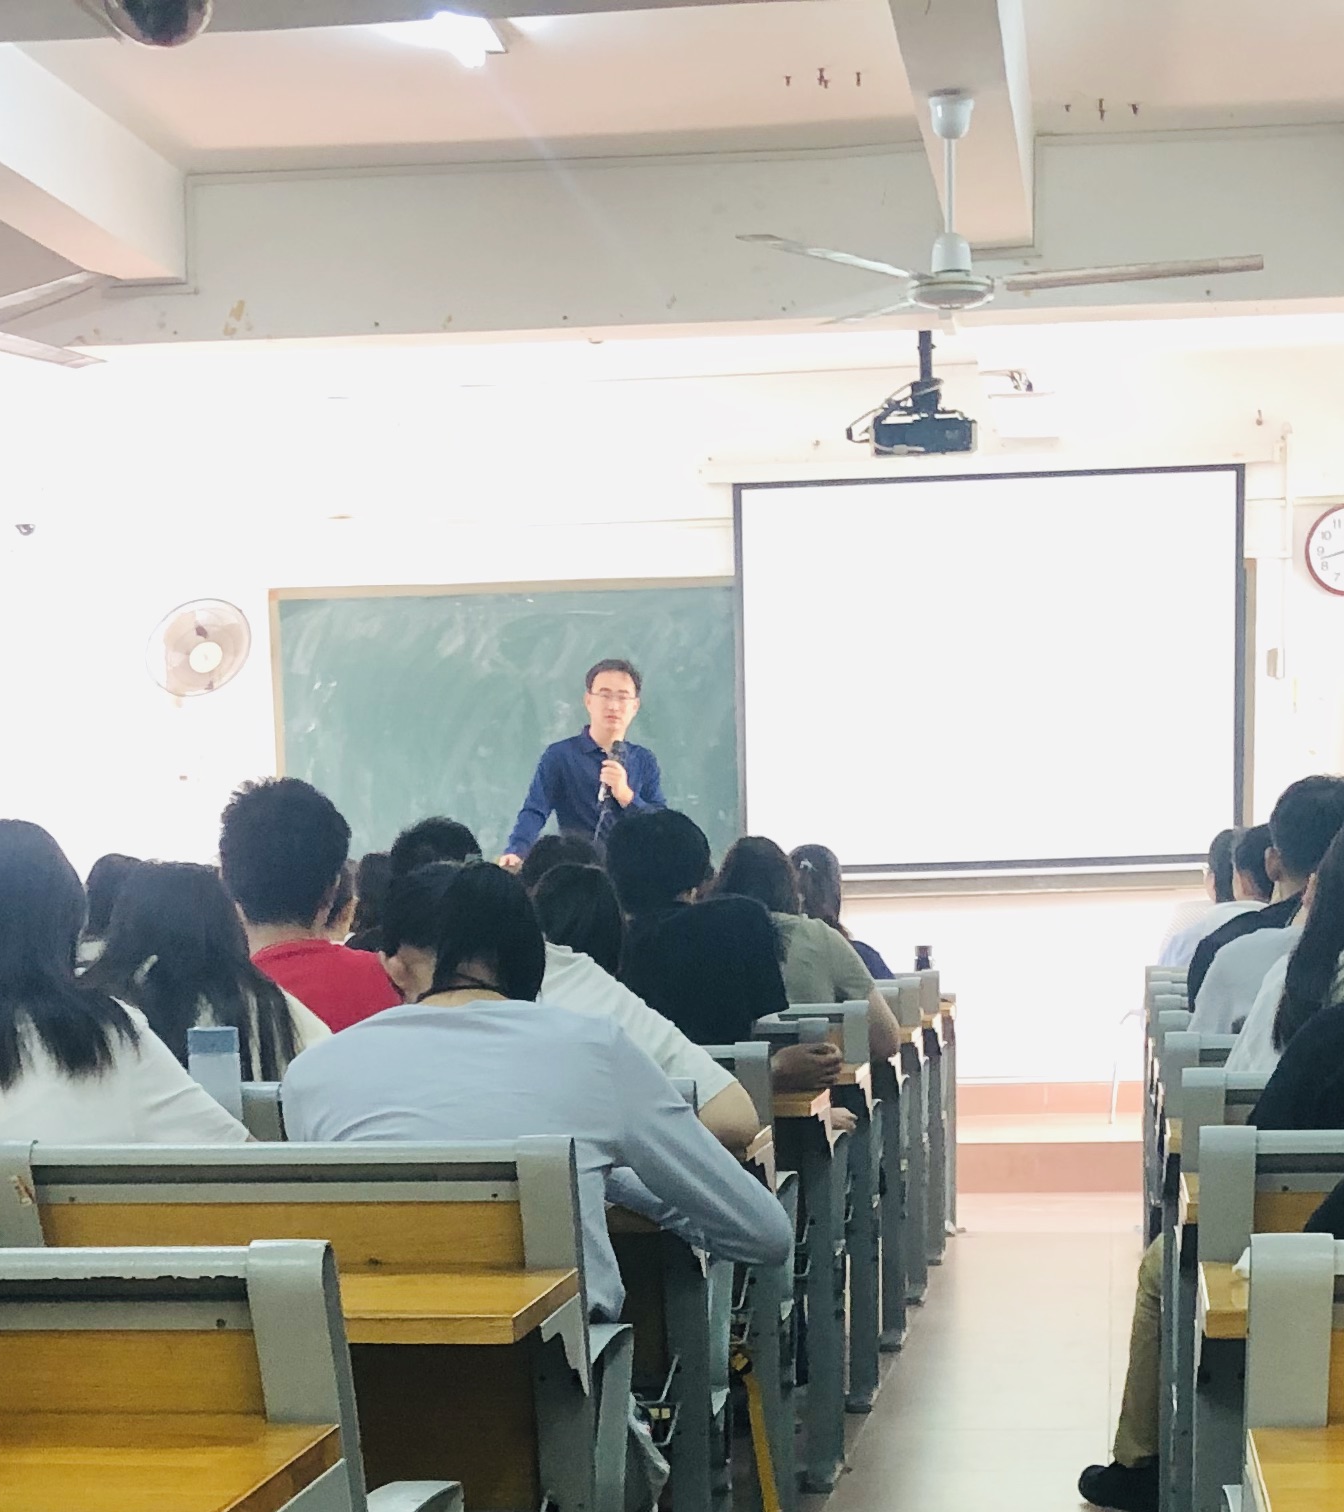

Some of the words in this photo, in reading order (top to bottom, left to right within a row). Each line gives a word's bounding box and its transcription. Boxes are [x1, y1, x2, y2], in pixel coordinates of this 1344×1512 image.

[1333, 518, 1342, 529] 11
[1321, 530, 1332, 541] 10
[1316, 546, 1325, 557] 9
[1320, 561, 1329, 571] 8
[1334, 572, 1341, 582] 7
